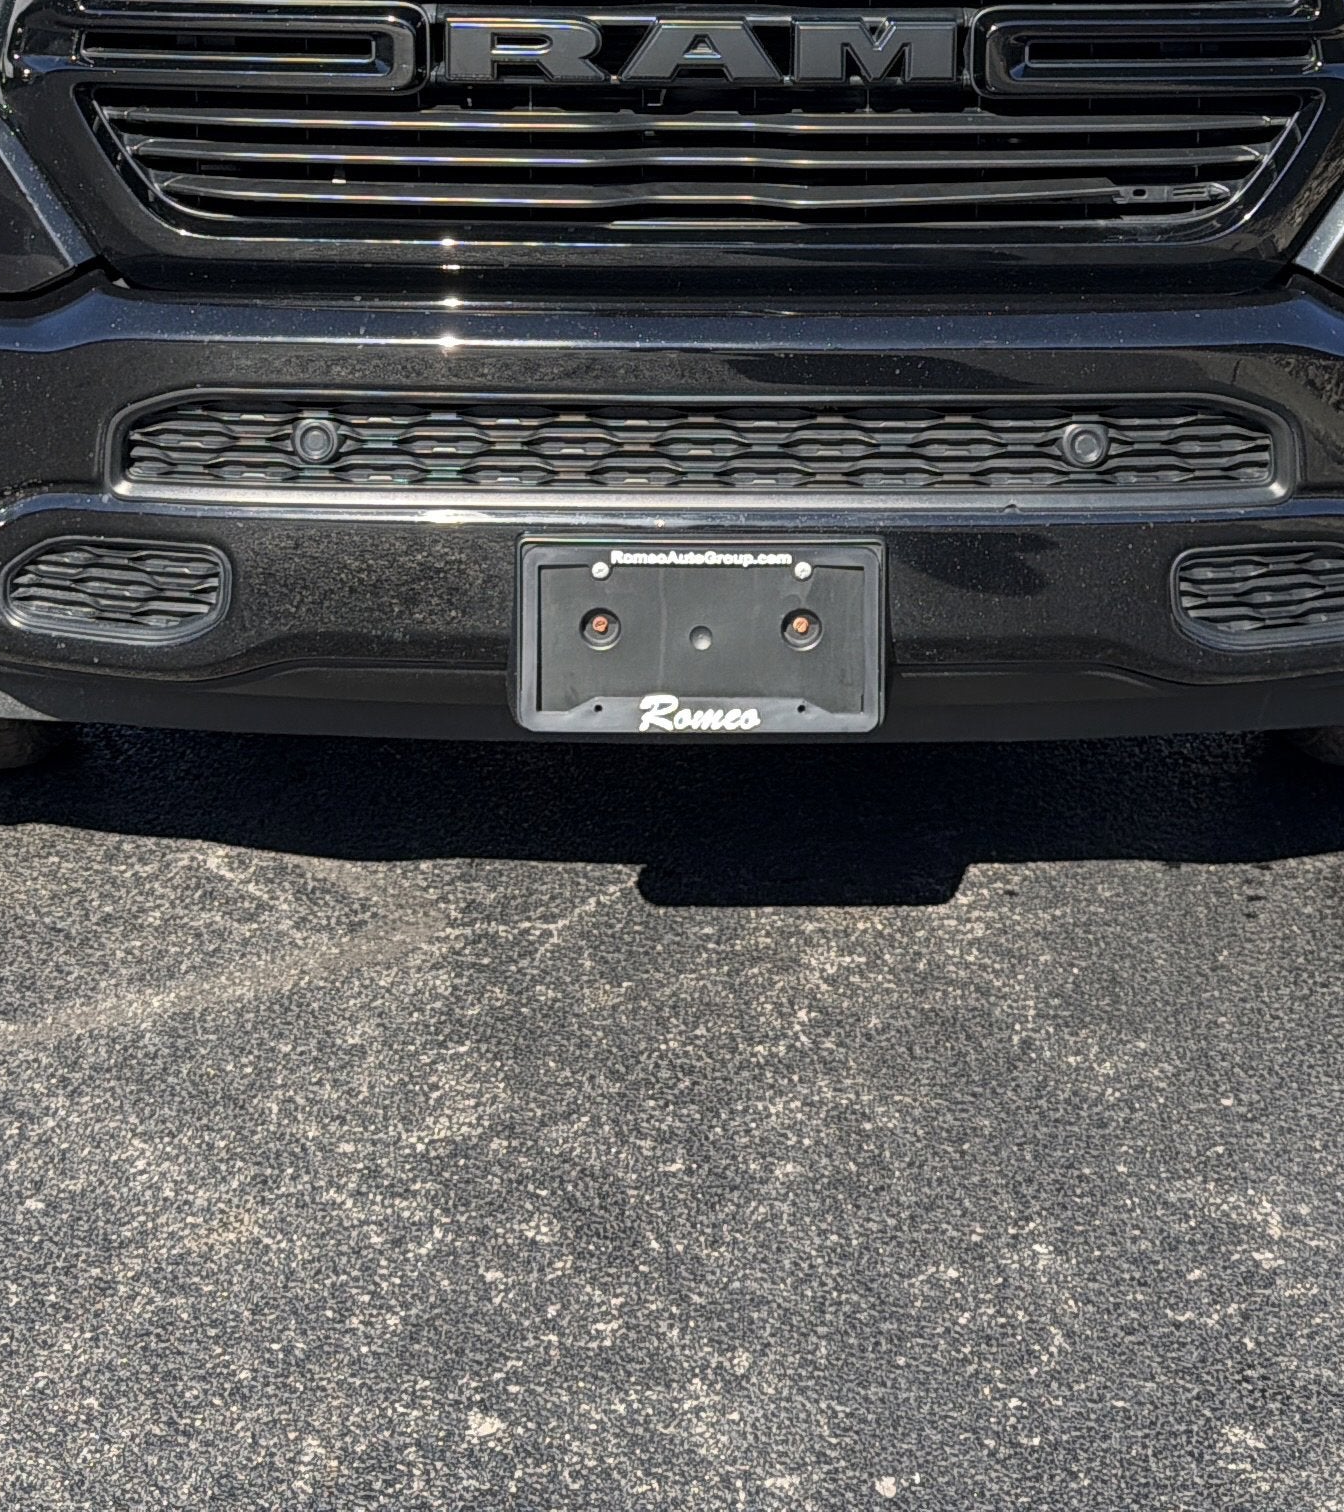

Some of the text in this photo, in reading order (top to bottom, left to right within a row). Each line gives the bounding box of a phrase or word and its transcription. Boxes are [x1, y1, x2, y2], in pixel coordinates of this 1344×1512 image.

[445, 17, 956, 82] RAM
[610, 549, 793, 568] RomeoAutoGroup.com
[638, 694, 761, 732] Romeo
